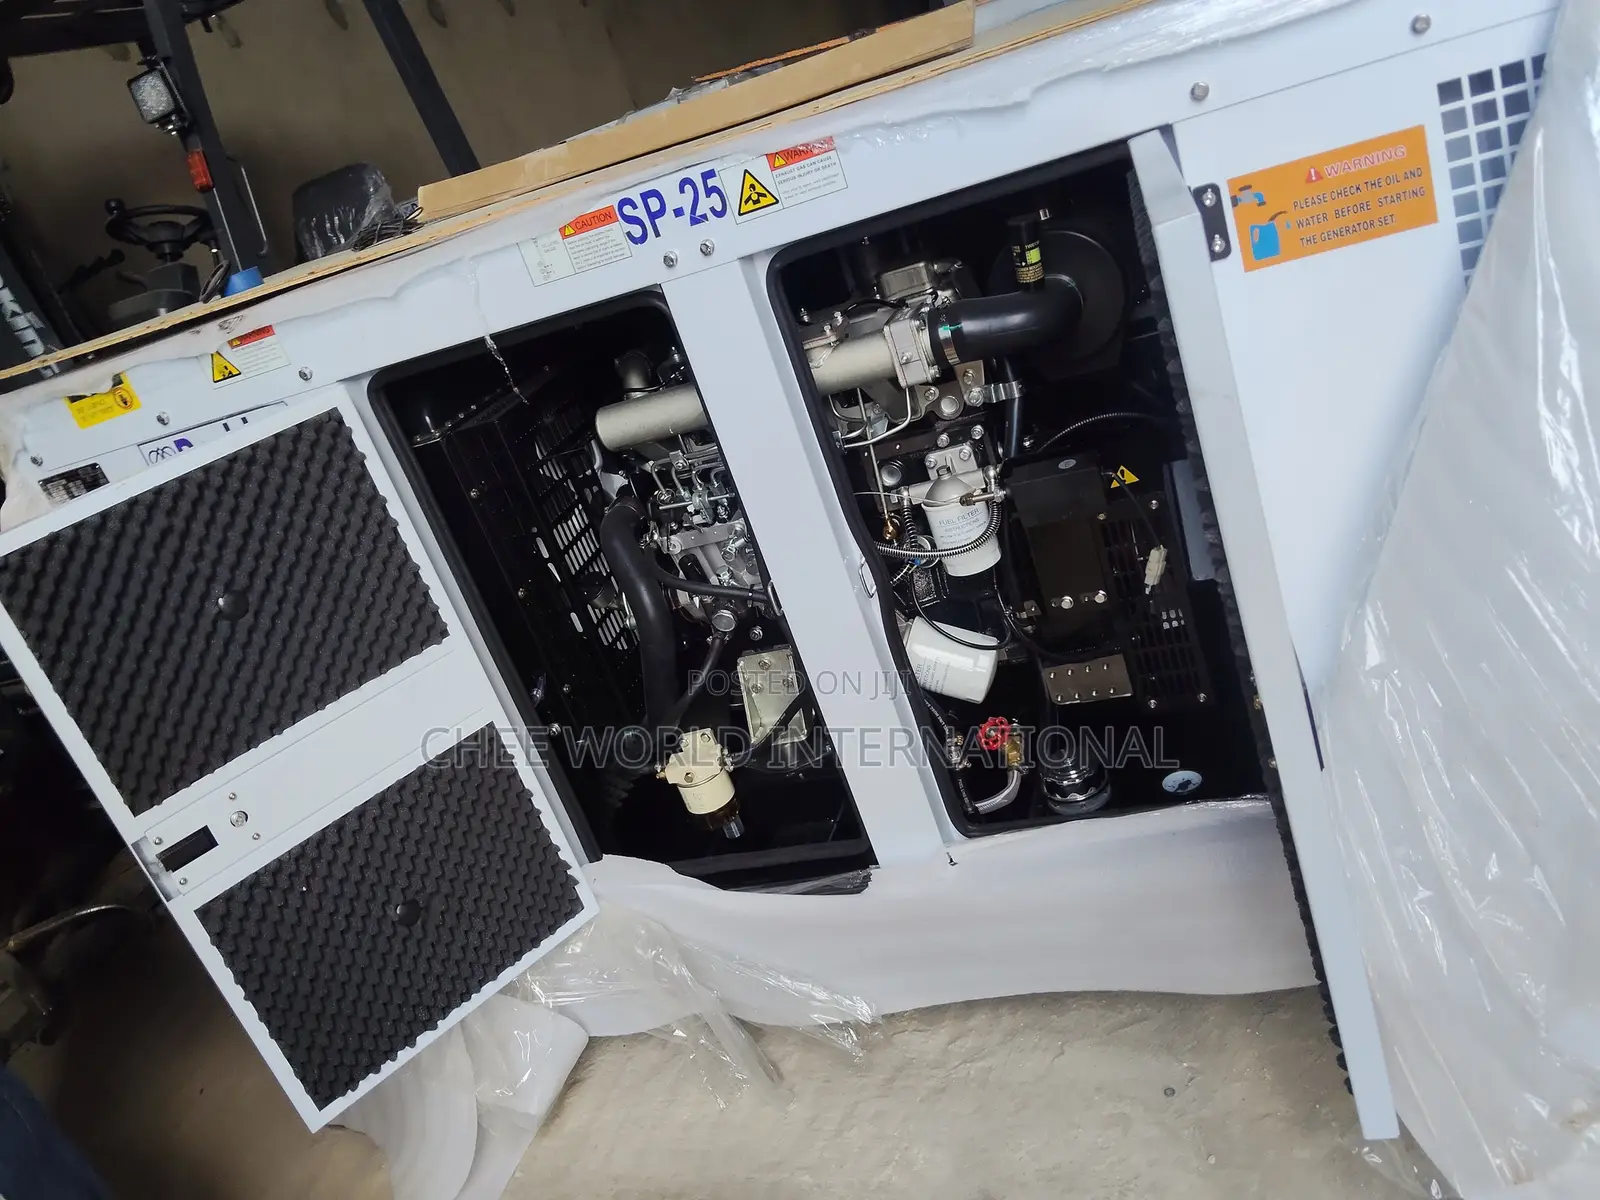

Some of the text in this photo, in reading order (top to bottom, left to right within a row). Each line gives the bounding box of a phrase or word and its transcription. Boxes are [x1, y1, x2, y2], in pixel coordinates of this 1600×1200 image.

[775, 168, 795, 178] EXHAUST
[797, 164, 806, 172] GAS
[817, 156, 832, 164] CAUSE
[778, 176, 796, 185] SERIOUS
[797, 169, 814, 178] INJURY
[1324, 145, 1406, 178] WARNING
[1293, 167, 1422, 211] PLEASE CHECK THE OIL AND
[574, 211, 612, 230] CAUTION
[617, 168, 727, 245] SP-25
[1296, 186, 1426, 229] WATER BEFORE STARTING
[1300, 213, 1397, 248] THE GENERATOR SET.
[957, 508, 980, 521] FILTER
